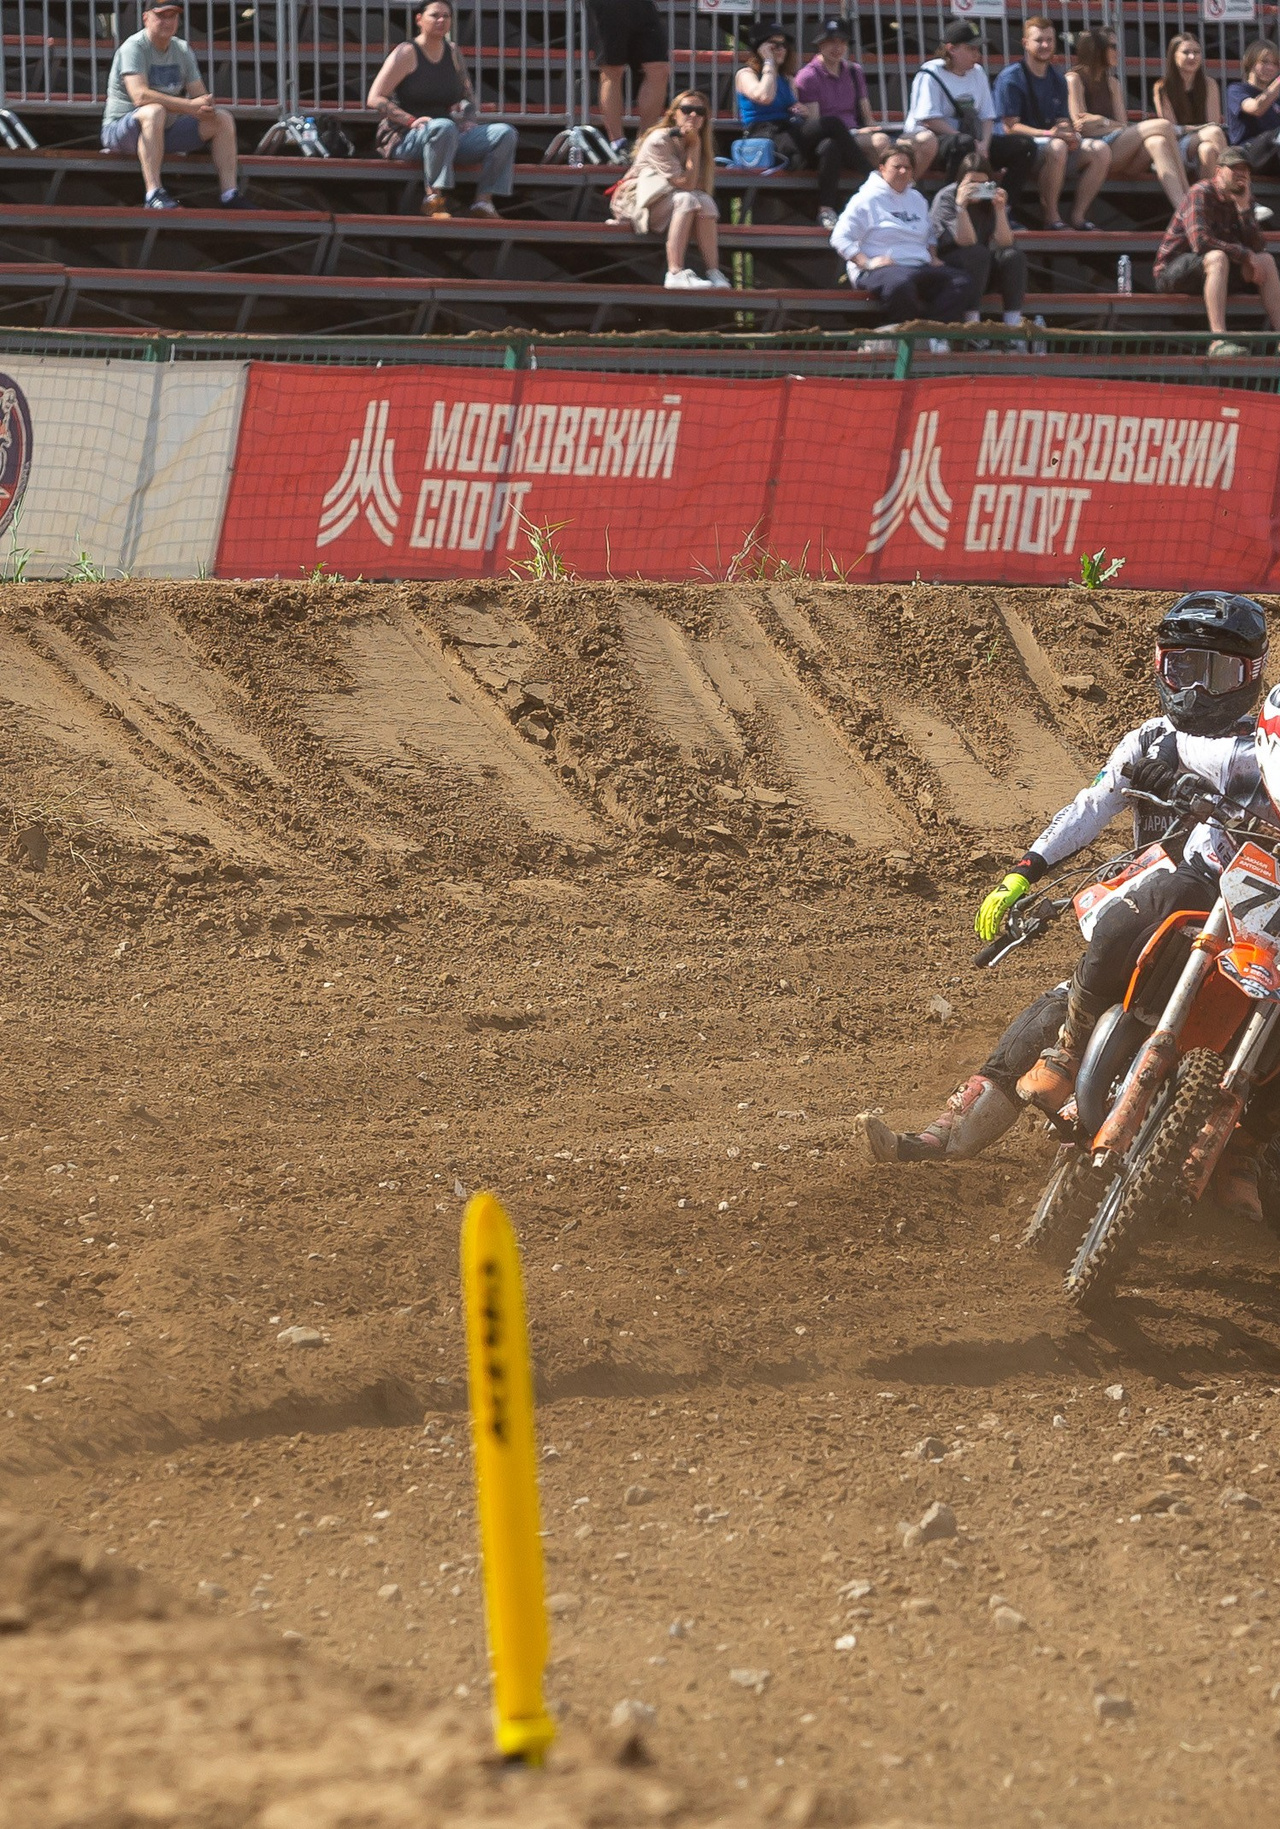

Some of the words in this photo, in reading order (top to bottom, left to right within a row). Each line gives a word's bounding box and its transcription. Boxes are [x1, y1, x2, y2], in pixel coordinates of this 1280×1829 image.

[425, 394, 682, 479] МОСКОВСКИЙ
[975, 407, 1240, 491] МОСКОВСКИЙ
[410, 479, 532, 551] СПОРТ
[964, 484, 1091, 555] СПОРТ
